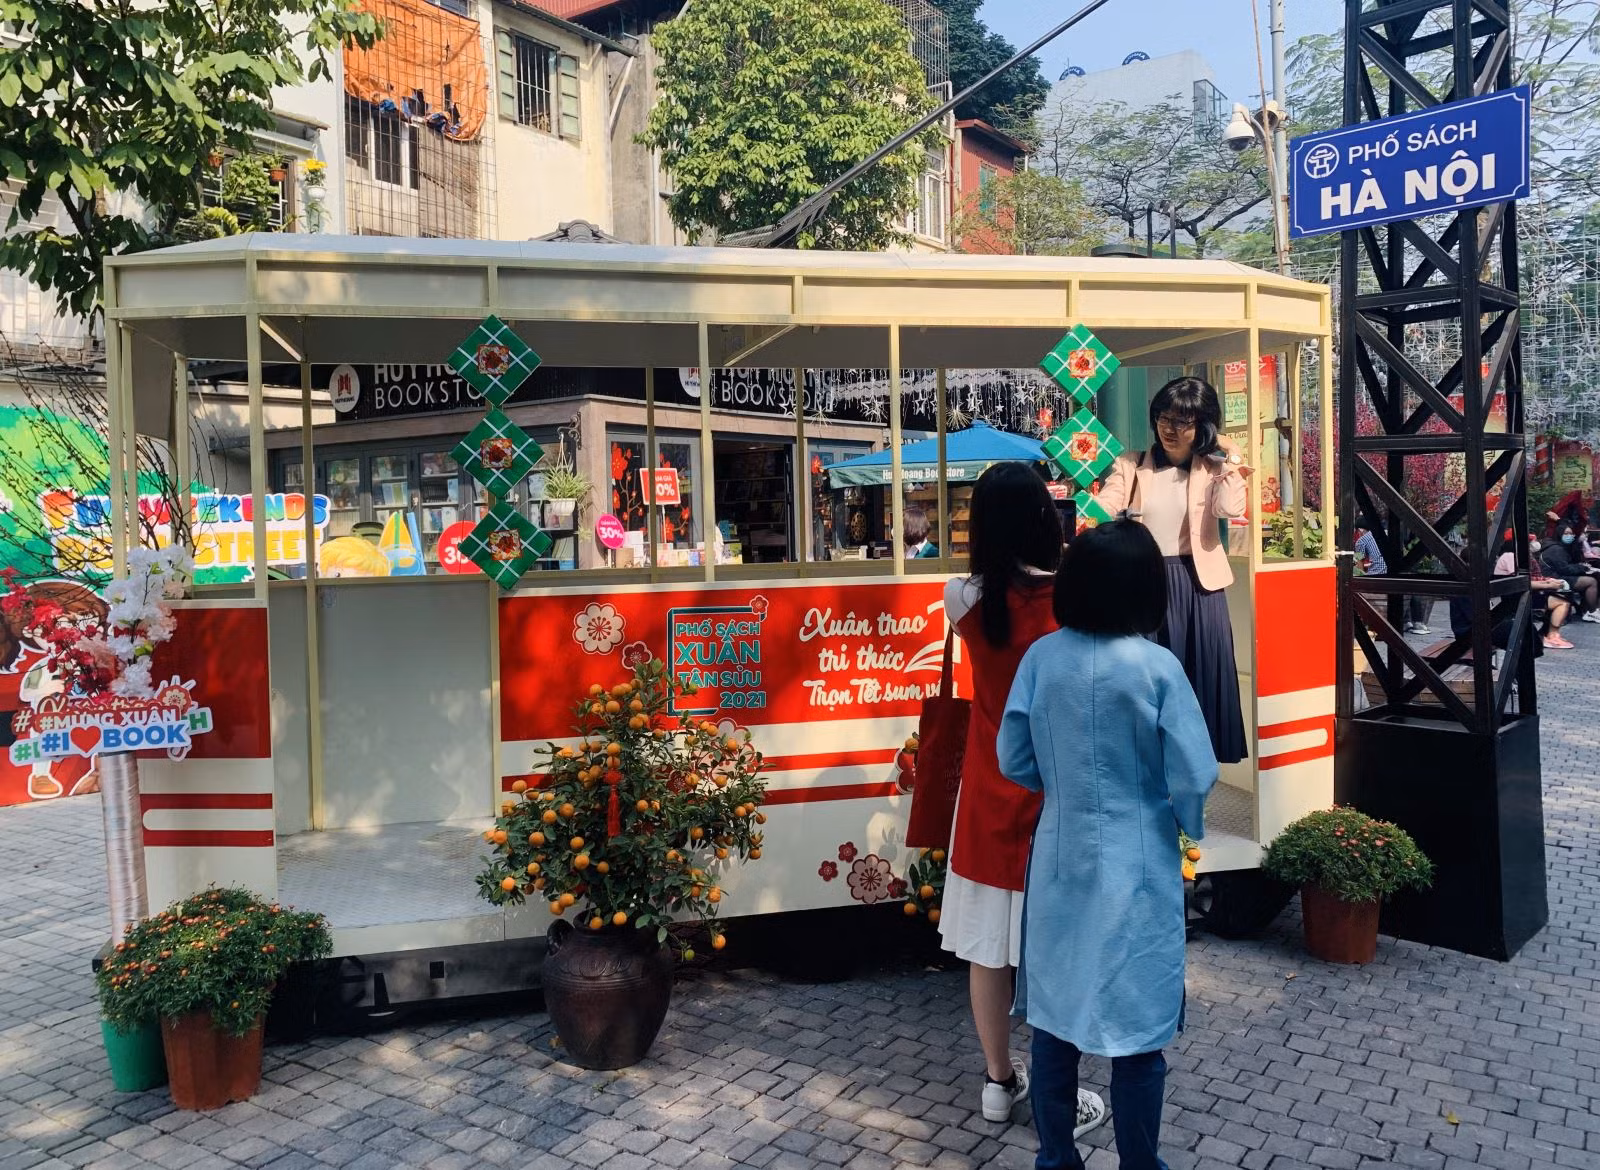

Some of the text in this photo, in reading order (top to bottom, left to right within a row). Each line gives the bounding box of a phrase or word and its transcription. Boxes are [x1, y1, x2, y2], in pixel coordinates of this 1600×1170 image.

[1348, 119, 1477, 165] PHỐ SÁCH
[1321, 149, 1496, 220] HÀ NỘI
[375, 378, 481, 410] BOOKSTO
[901, 468, 923, 480] oang
[925, 467, 965, 479] Boostore
[600, 527, 624, 540] 30%
[191, 530, 321, 565] STREE
[444, 546, 470, 565] 30
[675, 618, 760, 637] PHỐ SÁCH
[799, 607, 928, 642] Xuân trao
[675, 633, 761, 666] XUÂN
[857, 643, 905, 672] thức
[677, 665, 762, 688] TÂN SỬU
[720, 690, 767, 709] 2021
[803, 679, 853, 712] Trọn
[850, 677, 883, 705] Tết
[882, 682, 925, 702] sum
[120, 705, 177, 726] XUÂN
[103, 723, 186, 748] BOOK
